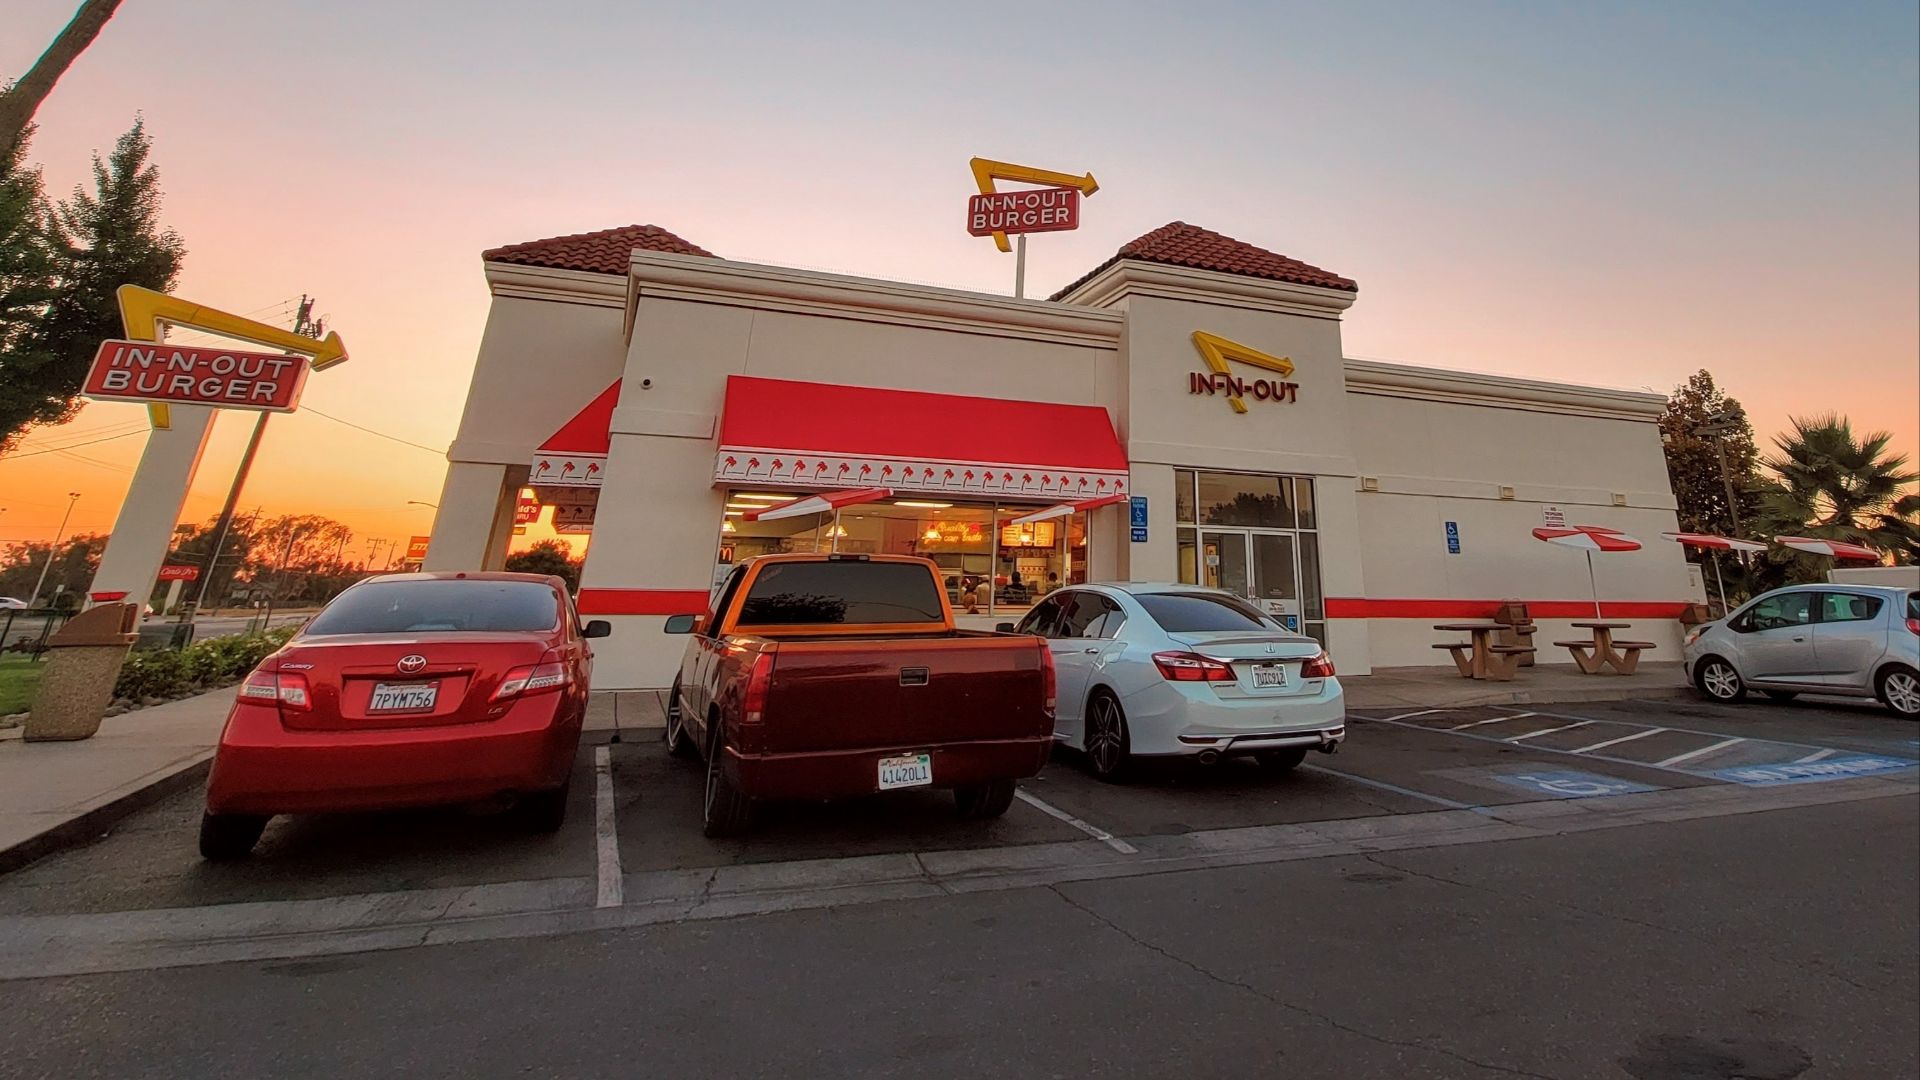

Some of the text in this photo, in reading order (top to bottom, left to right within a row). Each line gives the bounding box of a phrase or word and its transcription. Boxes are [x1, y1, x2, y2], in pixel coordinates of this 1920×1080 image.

[974, 191, 1071, 212] IN-N-OUT
[973, 208, 1069, 229] BURGER
[111, 347, 292, 379] IN-N-OUT
[102, 370, 277, 400] BURGER
[1189, 372, 1299, 403] IN-N-OUT
[374, 690, 434, 710] 7PYM756
[882, 766, 928, 784] 41420L1
